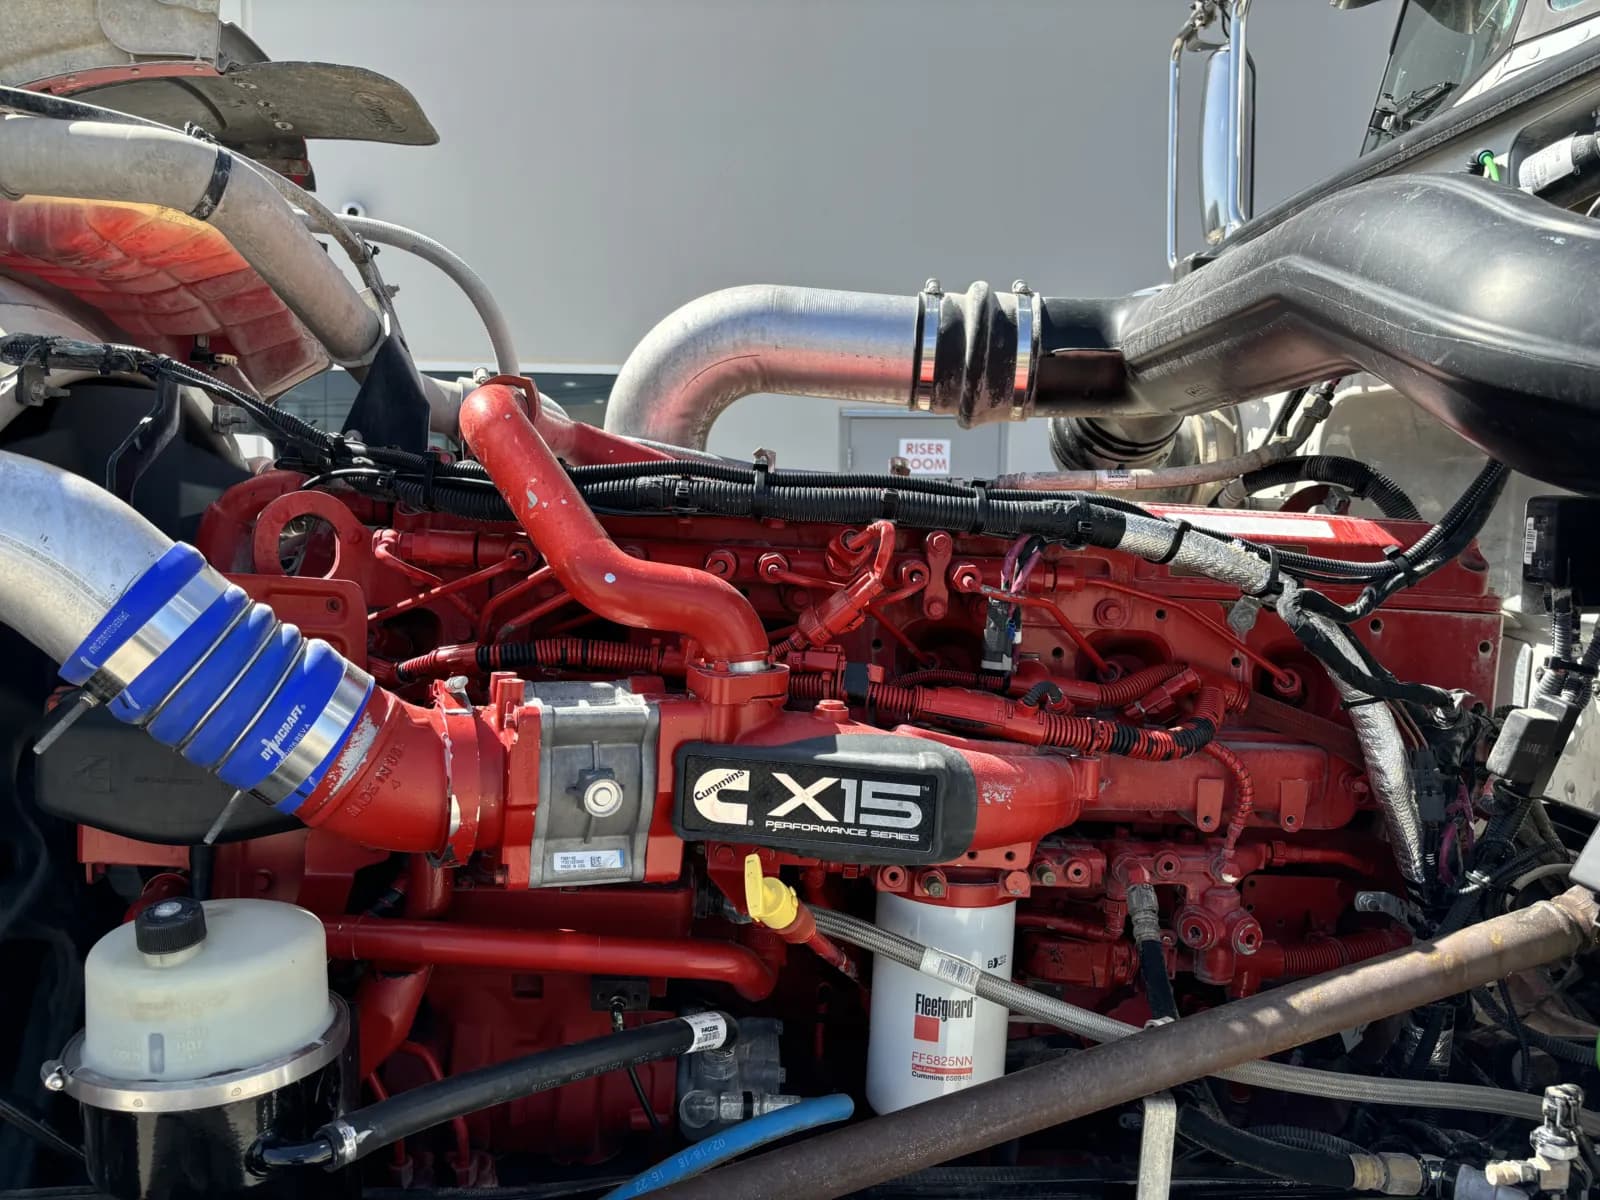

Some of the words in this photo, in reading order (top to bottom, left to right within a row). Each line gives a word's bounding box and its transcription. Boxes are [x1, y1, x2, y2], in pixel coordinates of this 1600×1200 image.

[905, 443, 944, 455] RISER
[910, 458, 948, 471] OOM
[260, 704, 304, 761] DYNACRAFT
[694, 769, 745, 801] Cummins
[766, 772, 923, 829] X15
[765, 820, 868, 837] PERFORMANCE
[870, 830, 920, 842] SERIES
[915, 993, 974, 1022] Fleetguard
[912, 1051, 973, 1066] FF5825NN
[912, 1071, 944, 1081] Cummins
